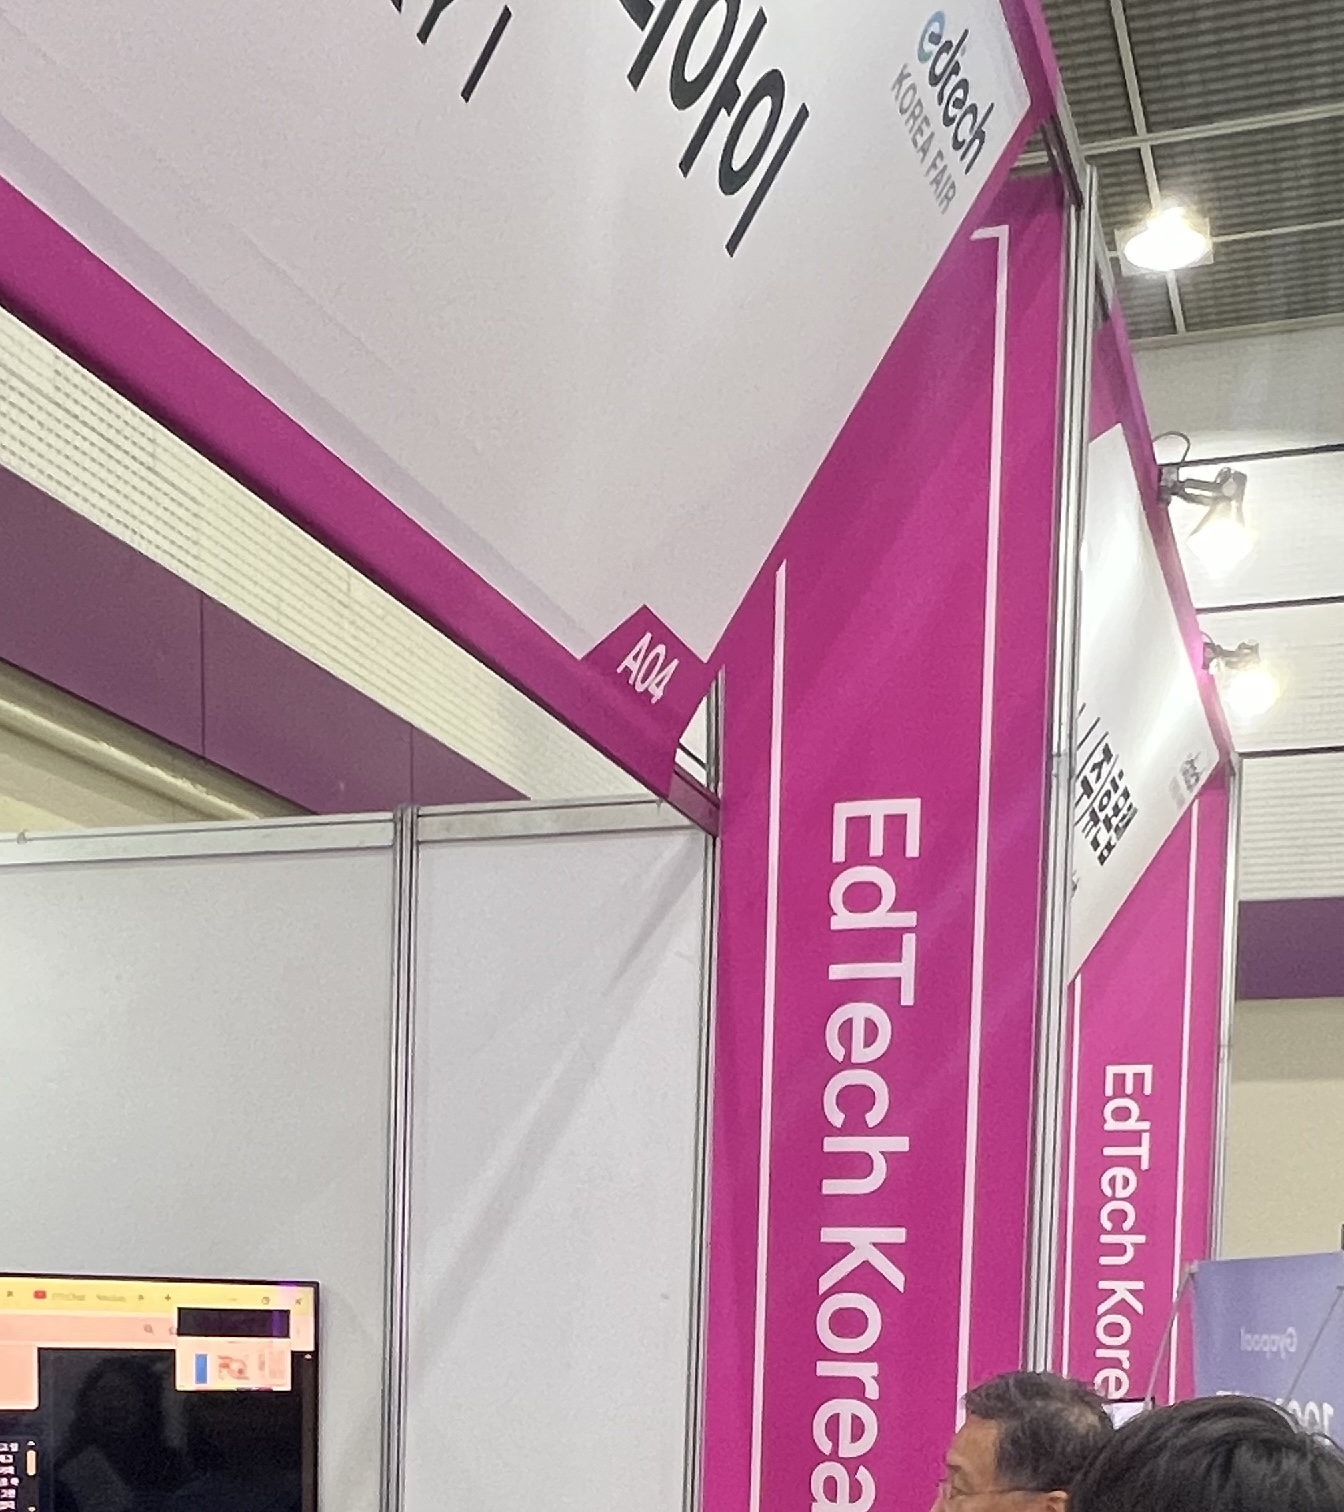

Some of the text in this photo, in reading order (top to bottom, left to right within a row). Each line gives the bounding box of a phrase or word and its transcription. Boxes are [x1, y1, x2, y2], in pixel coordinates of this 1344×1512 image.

[890, 63, 956, 215] KOREA FAIR
[917, 10, 995, 175] edtech
[616, 632, 680, 704] A04
[822, 798, 921, 1196] EdTech
[1094, 1065, 1154, 1400] EdTech Kore
